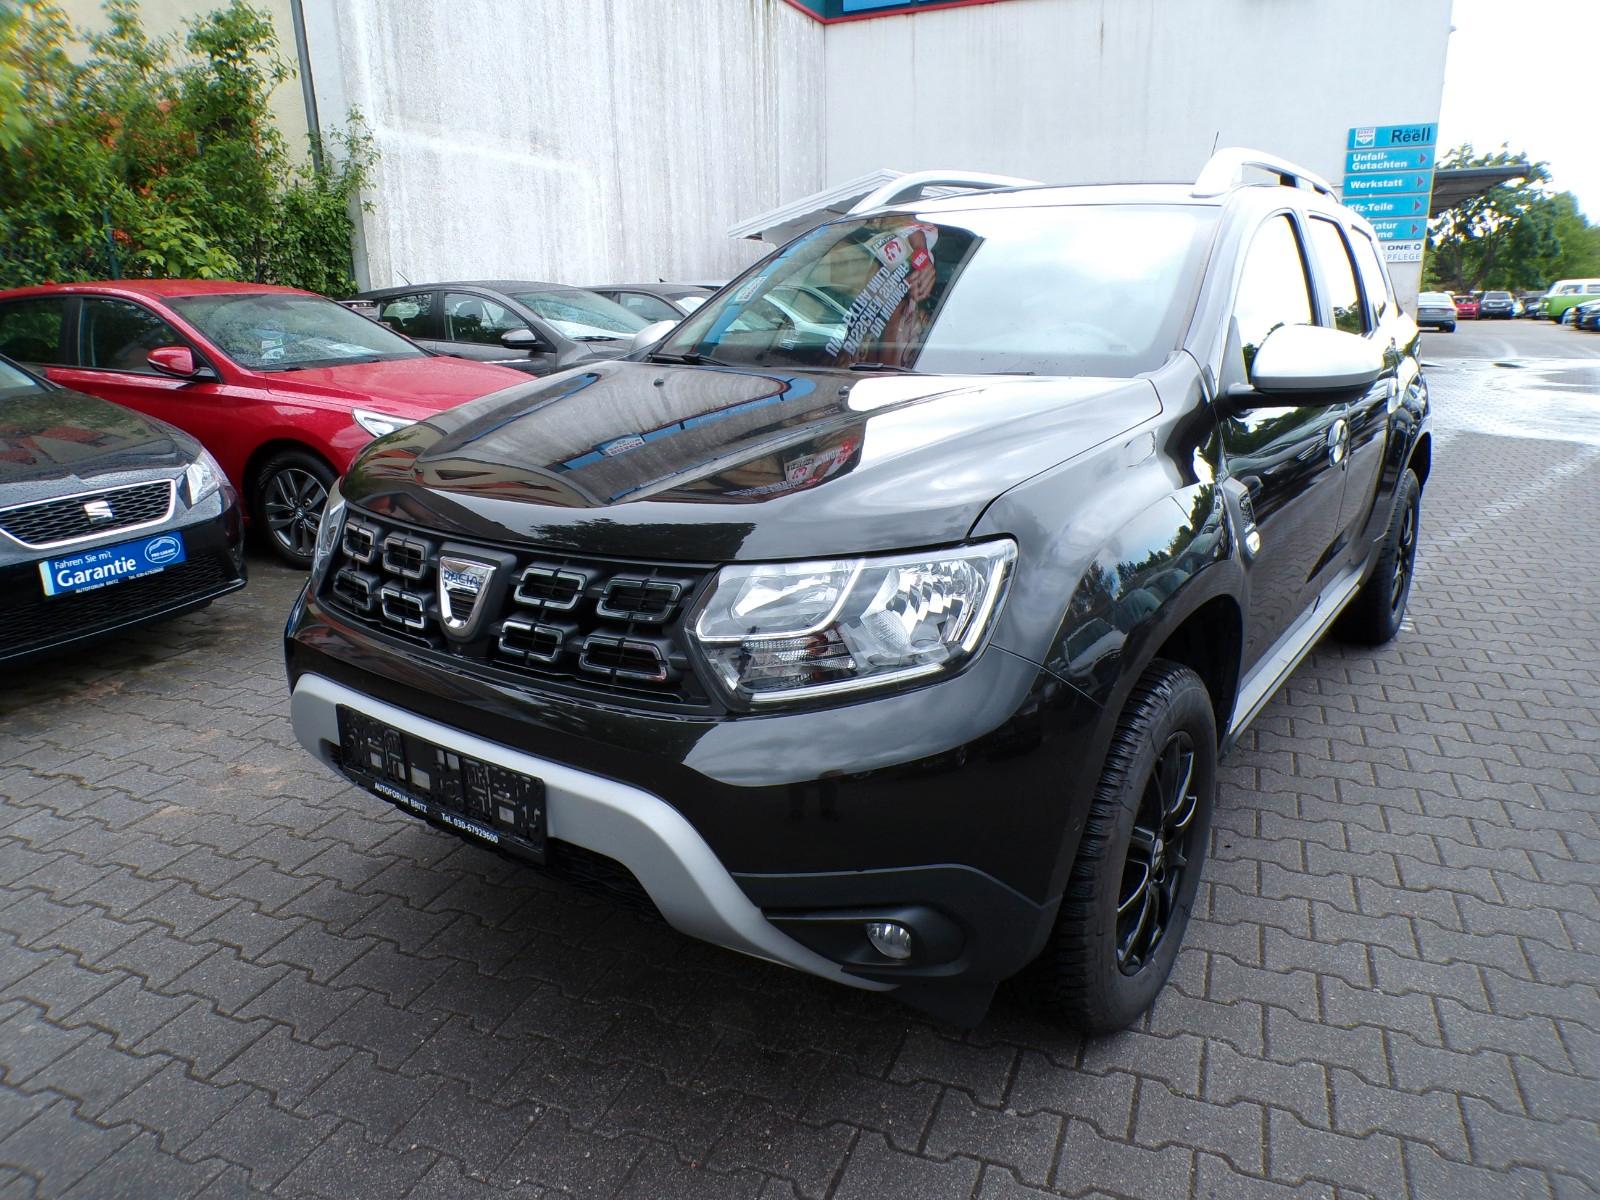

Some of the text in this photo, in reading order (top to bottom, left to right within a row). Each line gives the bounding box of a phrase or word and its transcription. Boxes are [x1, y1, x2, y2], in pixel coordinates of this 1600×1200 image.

[1391, 128, 1431, 143] Reell
[1352, 161, 1408, 170] Gutachten
[1353, 153, 1388, 162] Unfall-
[1350, 179, 1403, 189] Werkstatt
[1373, 222, 1398, 230] ratur
[54, 550, 112, 569] Fahren Sie mit
[57, 556, 136, 587] Garantie
[444, 569, 480, 588] DACIA
[374, 782, 428, 814] AUTOFORUM BRITZ
[453, 818, 499, 844] 030-67929600
